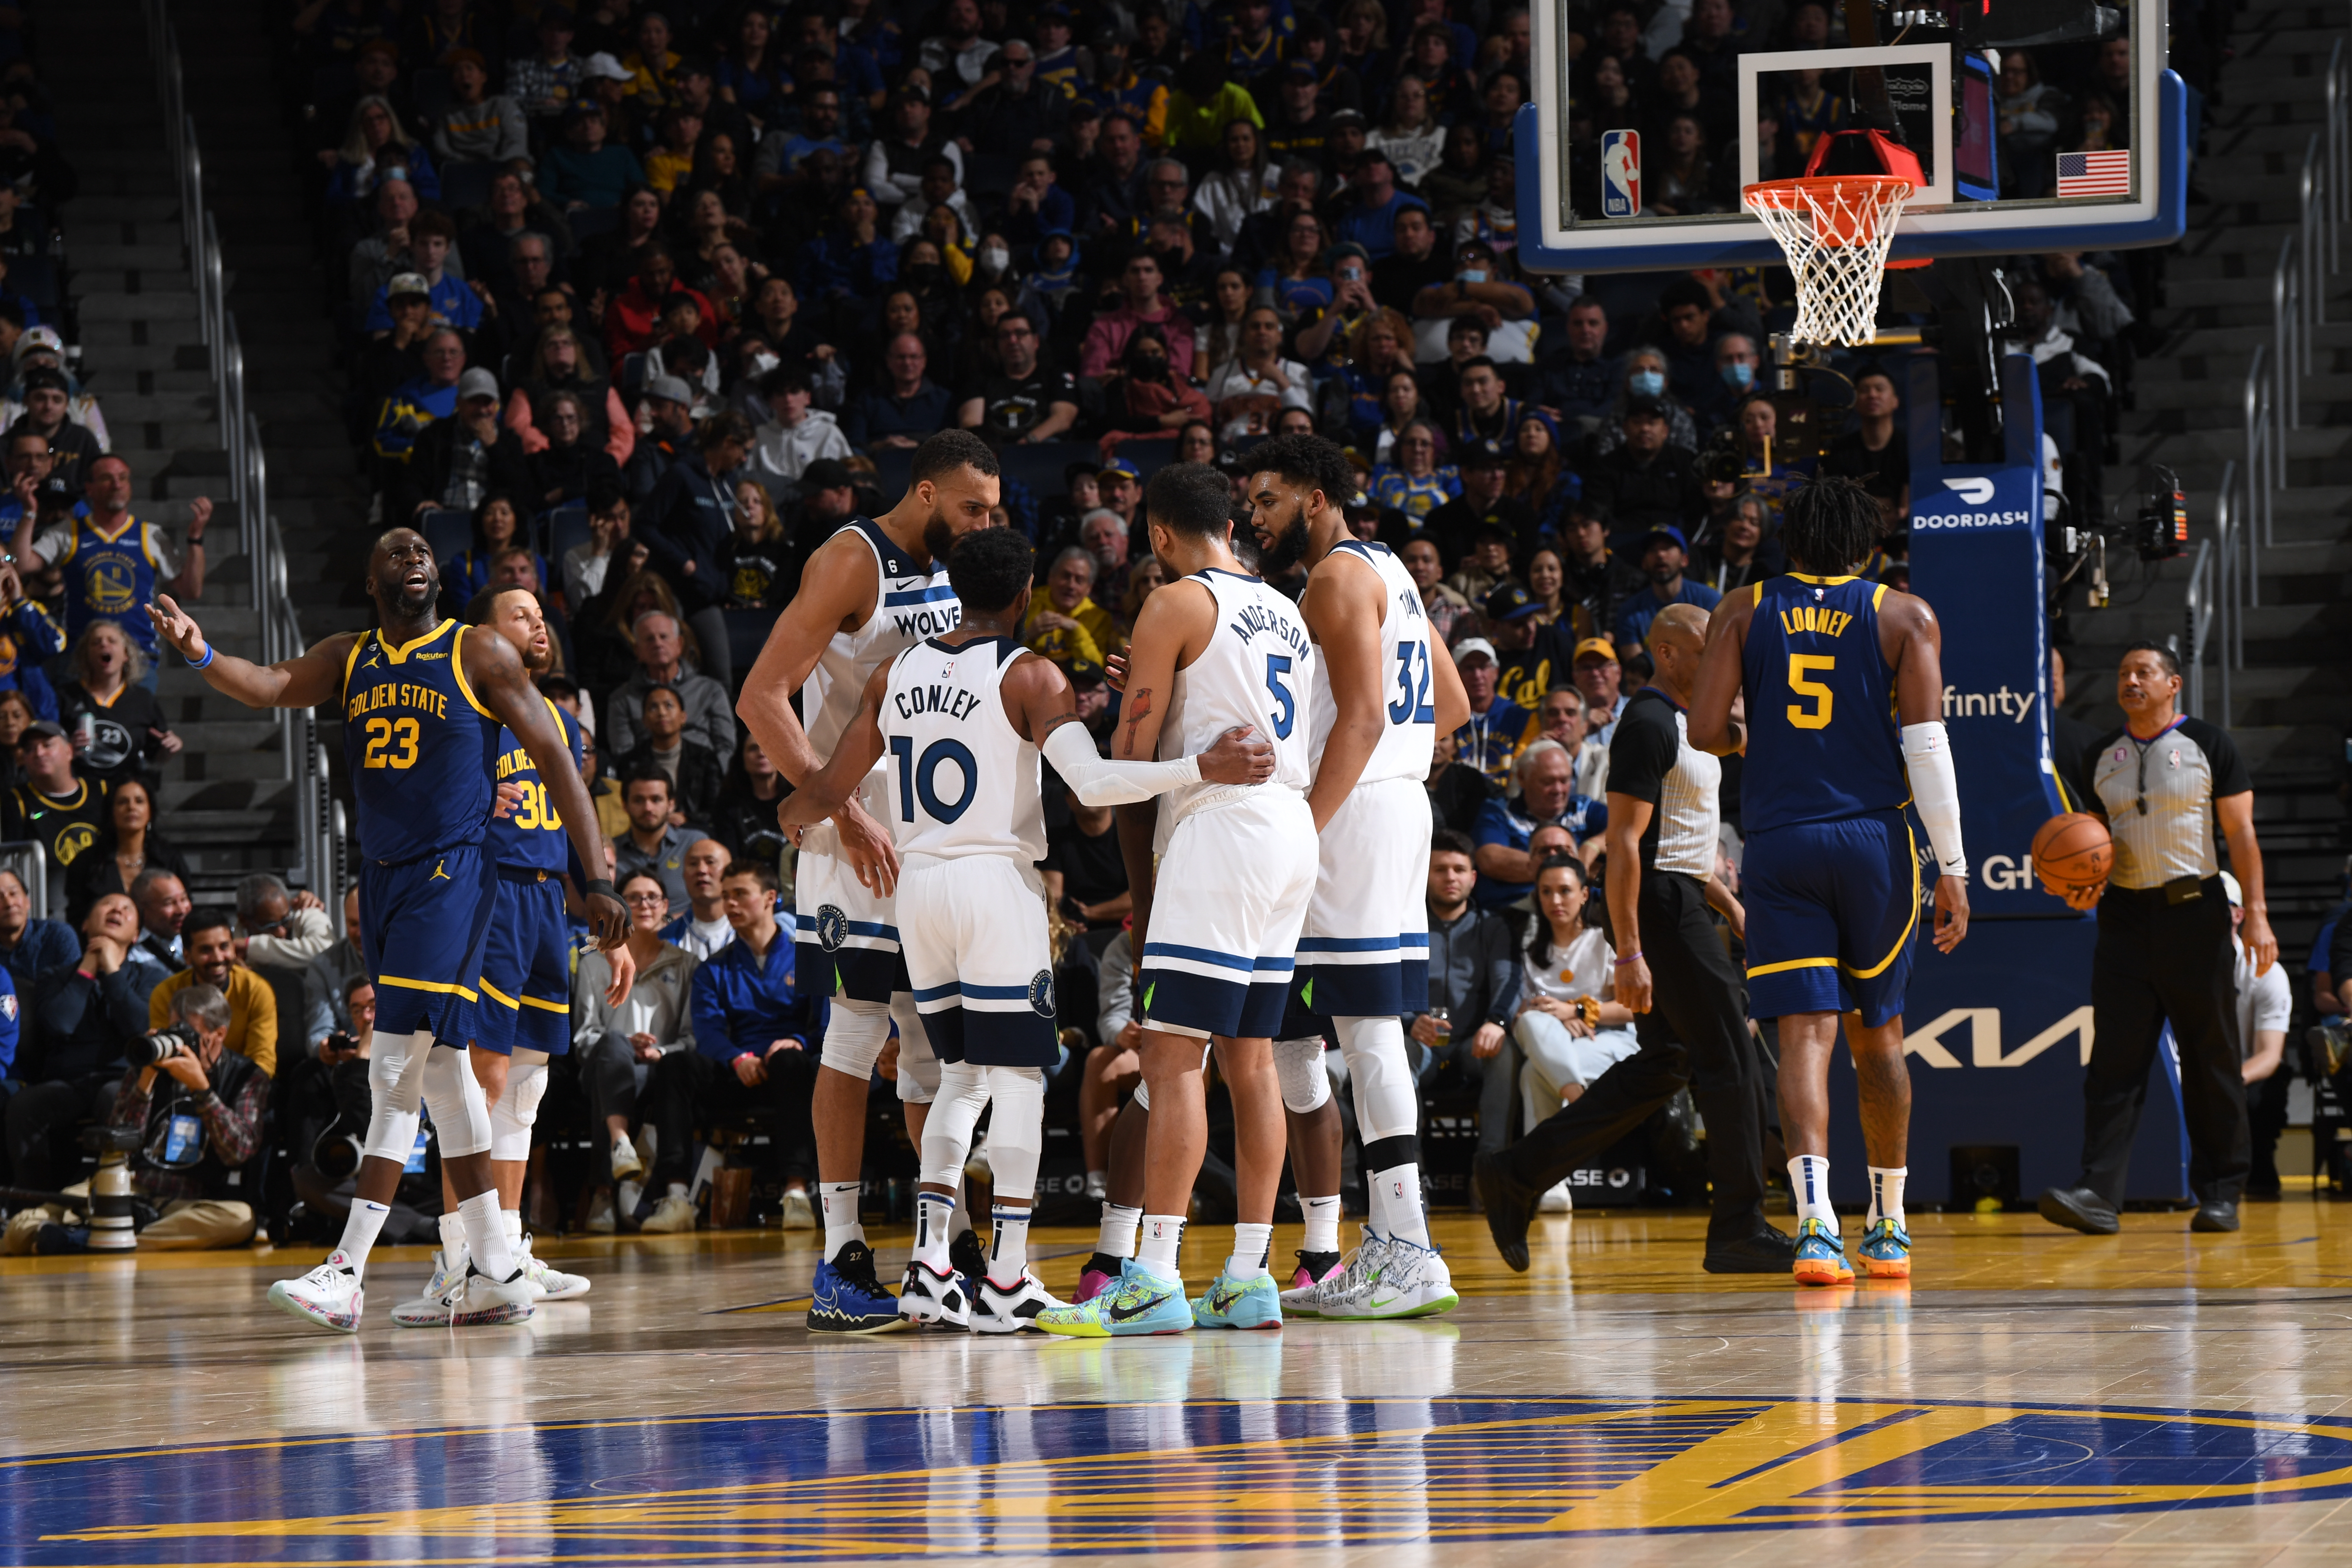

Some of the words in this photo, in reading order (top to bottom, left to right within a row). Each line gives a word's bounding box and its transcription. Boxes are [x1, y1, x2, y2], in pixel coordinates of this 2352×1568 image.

[1608, 198, 1627, 212] NBA
[1913, 511, 2029, 529] DOORDASH
[887, 559, 898, 574] 6
[893, 605, 961, 638] WOLVE
[1230, 605, 1310, 662] ANDERSON
[1780, 606, 1853, 637] LOONEY
[416, 652, 448, 660] Rakuten
[1266, 653, 1295, 742] 5
[1388, 640, 1435, 725] 32
[1497, 658, 1551, 710] Cal
[1787, 653, 1835, 730] 5
[348, 683, 397, 723] GOLDEN
[400, 683, 448, 720] STATE
[895, 684, 981, 722] CONLEY
[1942, 684, 2036, 727] finity
[101, 728, 122, 745] 23
[363, 717, 420, 769] 23
[889, 735, 978, 825] 10
[514, 780, 563, 831] 30
[79, 830, 93, 848] 0
[828, 906, 847, 945] TIMBERWOLVES
[1030, 971, 1045, 1002] MINNESOTA
[849, 1251, 862, 1261] 27
